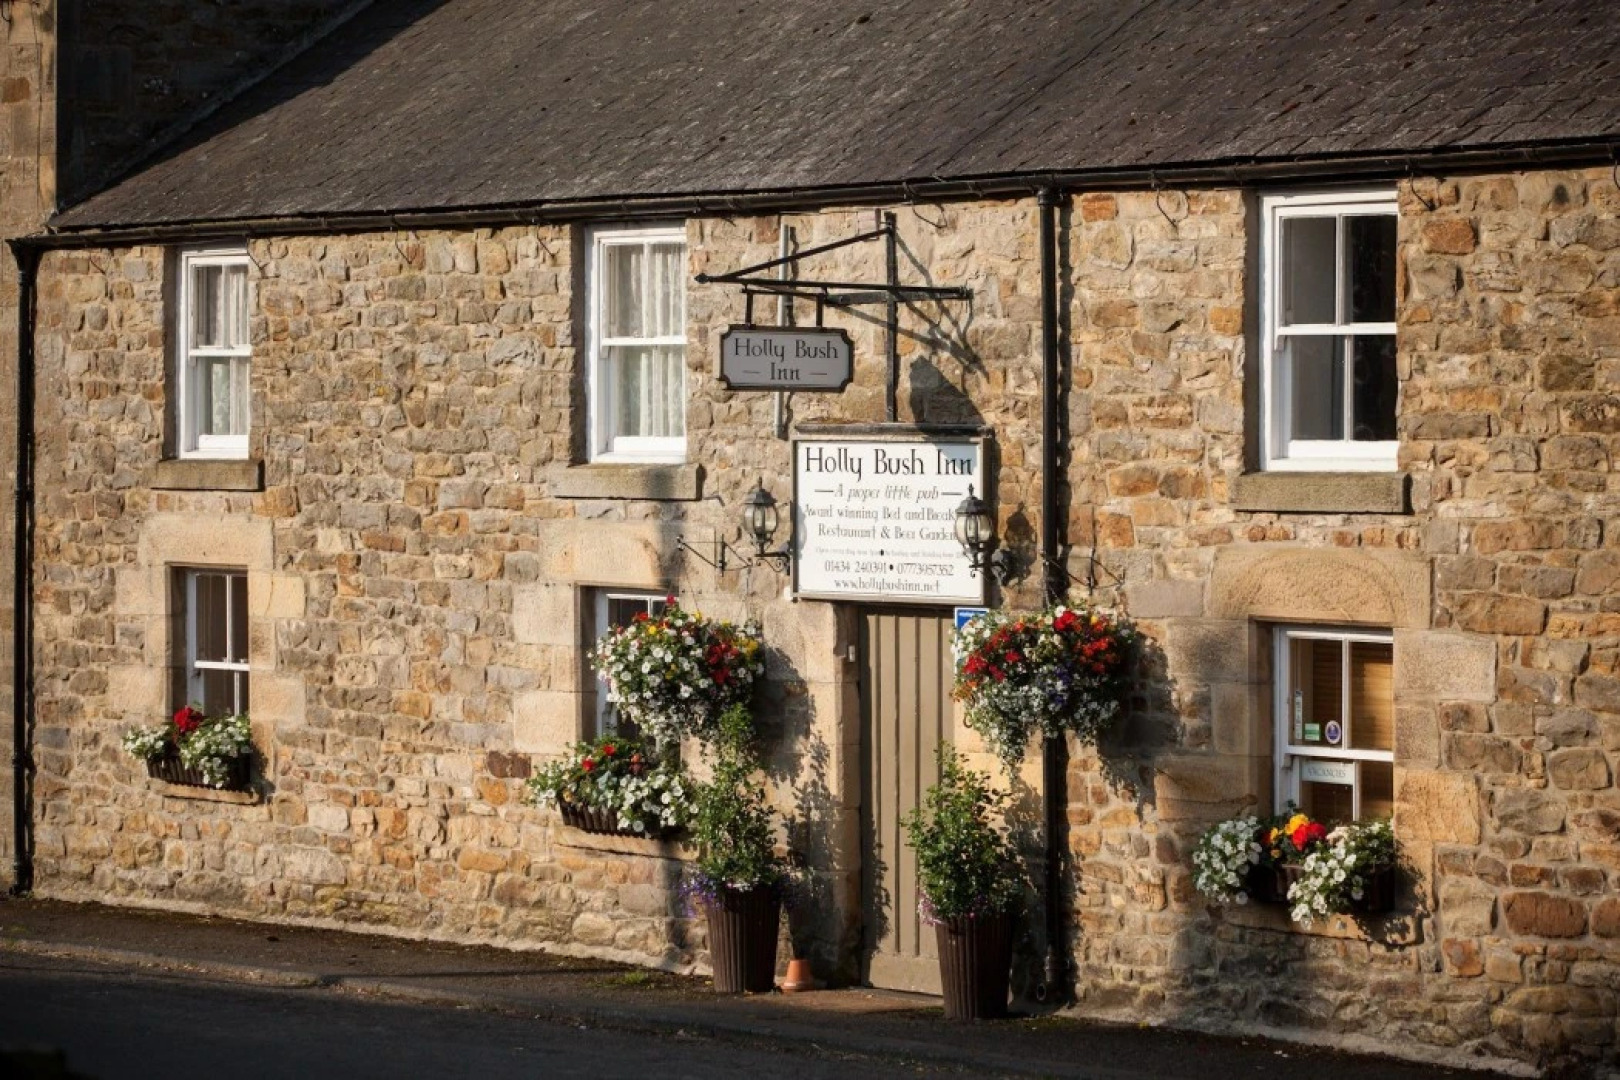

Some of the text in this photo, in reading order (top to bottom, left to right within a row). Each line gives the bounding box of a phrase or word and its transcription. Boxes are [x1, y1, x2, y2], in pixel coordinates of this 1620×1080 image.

[735, 338, 838, 362] Holly Bush
[770, 362, 800, 380] Inn
[805, 447, 973, 482] Holly Bush Inn
[834, 484, 939, 503] A proper little pub
[805, 503, 833, 518] Award
[837, 505, 879, 522] winning
[882, 506, 901, 520] Bed
[904, 507, 925, 521] and
[818, 523, 876, 539] Restaurant
[880, 526, 891, 539] &
[895, 526, 916, 539] Beer
[824, 560, 851, 573] 01434
[855, 561, 887, 574] 240391
[834, 577, 940, 593] www.hollybushinn.net
